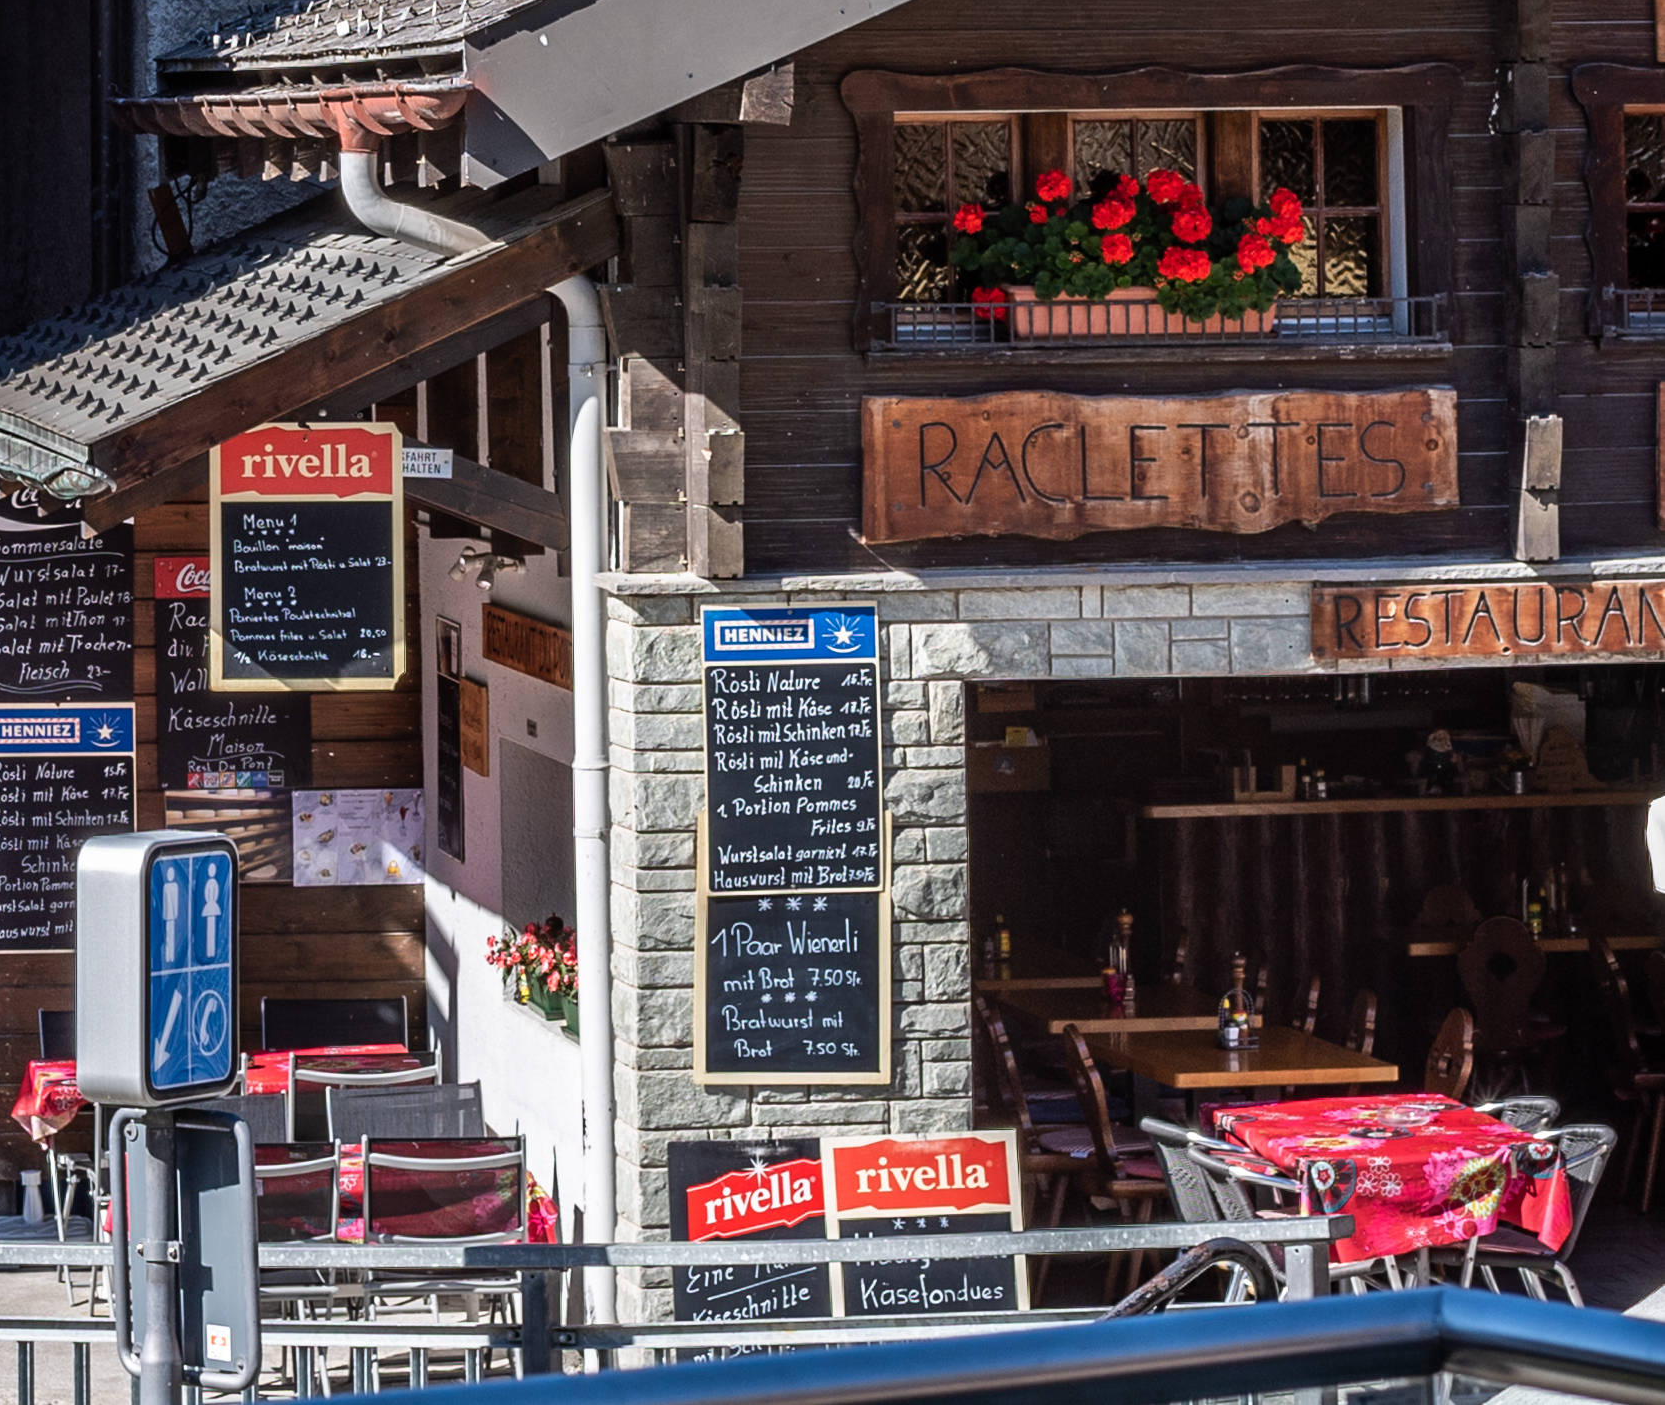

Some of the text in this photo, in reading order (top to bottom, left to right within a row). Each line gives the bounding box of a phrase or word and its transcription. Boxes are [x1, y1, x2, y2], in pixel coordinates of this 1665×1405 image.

[241, 443, 373, 478] rivella
[402, 452, 437, 464] FAHRT
[918, 421, 1408, 509] RACLETTES
[403, 462, 442, 475] HALTEN
[243, 513, 298, 531] Menu 1
[233, 539, 281, 554] Bouillon
[234, 559, 288, 573] Bratwurst
[290, 559, 309, 572] mit
[311, 555, 337, 570] Rösti
[347, 556, 371, 568] Salat
[176, 562, 210, 592] Coca
[45, 587, 72, 606] mit
[76, 586, 114, 606] Poulet
[244, 585, 297, 601] Menu 2
[45, 611, 72, 628] mit
[229, 606, 357, 624] Paniertes Pouletschnitzel
[1333, 586, 1665, 651] RESTAURAN
[230, 628, 276, 642] Pommes
[279, 629, 304, 642] frites
[319, 629, 348, 640] Salat
[359, 627, 387, 639] 20.50
[724, 627, 805, 643] HENNIEZ
[38, 637, 65, 654] mit
[233, 651, 252, 665] 1/2
[257, 649, 330, 662] Käseschnitte
[18, 659, 71, 685] Fleisch
[710, 668, 761, 694] Rösti
[766, 669, 821, 693] Nature
[711, 697, 762, 721] Rösti
[765, 695, 794, 720] mit
[797, 696, 833, 719] Käse
[1, 724, 72, 738] HENNIEZ
[713, 720, 846, 745] Rösti mit Schinken
[206, 733, 266, 757] Maison
[219, 761, 236, 772] Du
[240, 756, 274, 770] Pont
[714, 751, 755, 773] Rösti
[759, 749, 784, 771] mit
[788, 747, 824, 769] Käse
[34, 762, 76, 781] Nature
[753, 773, 823, 794] Schinken
[32, 786, 54, 803] mit
[60, 785, 90, 802] Käse
[731, 796, 791, 818] Portion
[795, 796, 858, 815] Pommes
[31, 810, 53, 827] mit
[54, 809, 104, 827] Schinken
[810, 818, 853, 837] Frites
[27, 835, 50, 851] mit
[717, 843, 847, 866] Wurstsalat garniert
[21, 855, 76, 874] Schinke
[40, 876, 75, 893] Pomme
[713, 864, 848, 890] Hauswurst mit Brot
[49, 899, 76, 913] garn
[54, 920, 75, 935] mit
[711, 917, 859, 958] 1 Paar Wienerli
[723, 969, 756, 993] mit
[758, 967, 795, 990] Brot
[807, 967, 843, 988] 7.50
[721, 1004, 844, 1031] Bratwurst mit
[733, 1038, 773, 1058] Brot
[802, 1039, 838, 1056] 7.50
[855, 1152, 990, 1194] rivella
[704, 1169, 814, 1225] rivella
[860, 1273, 1005, 1310] Käsefondues
